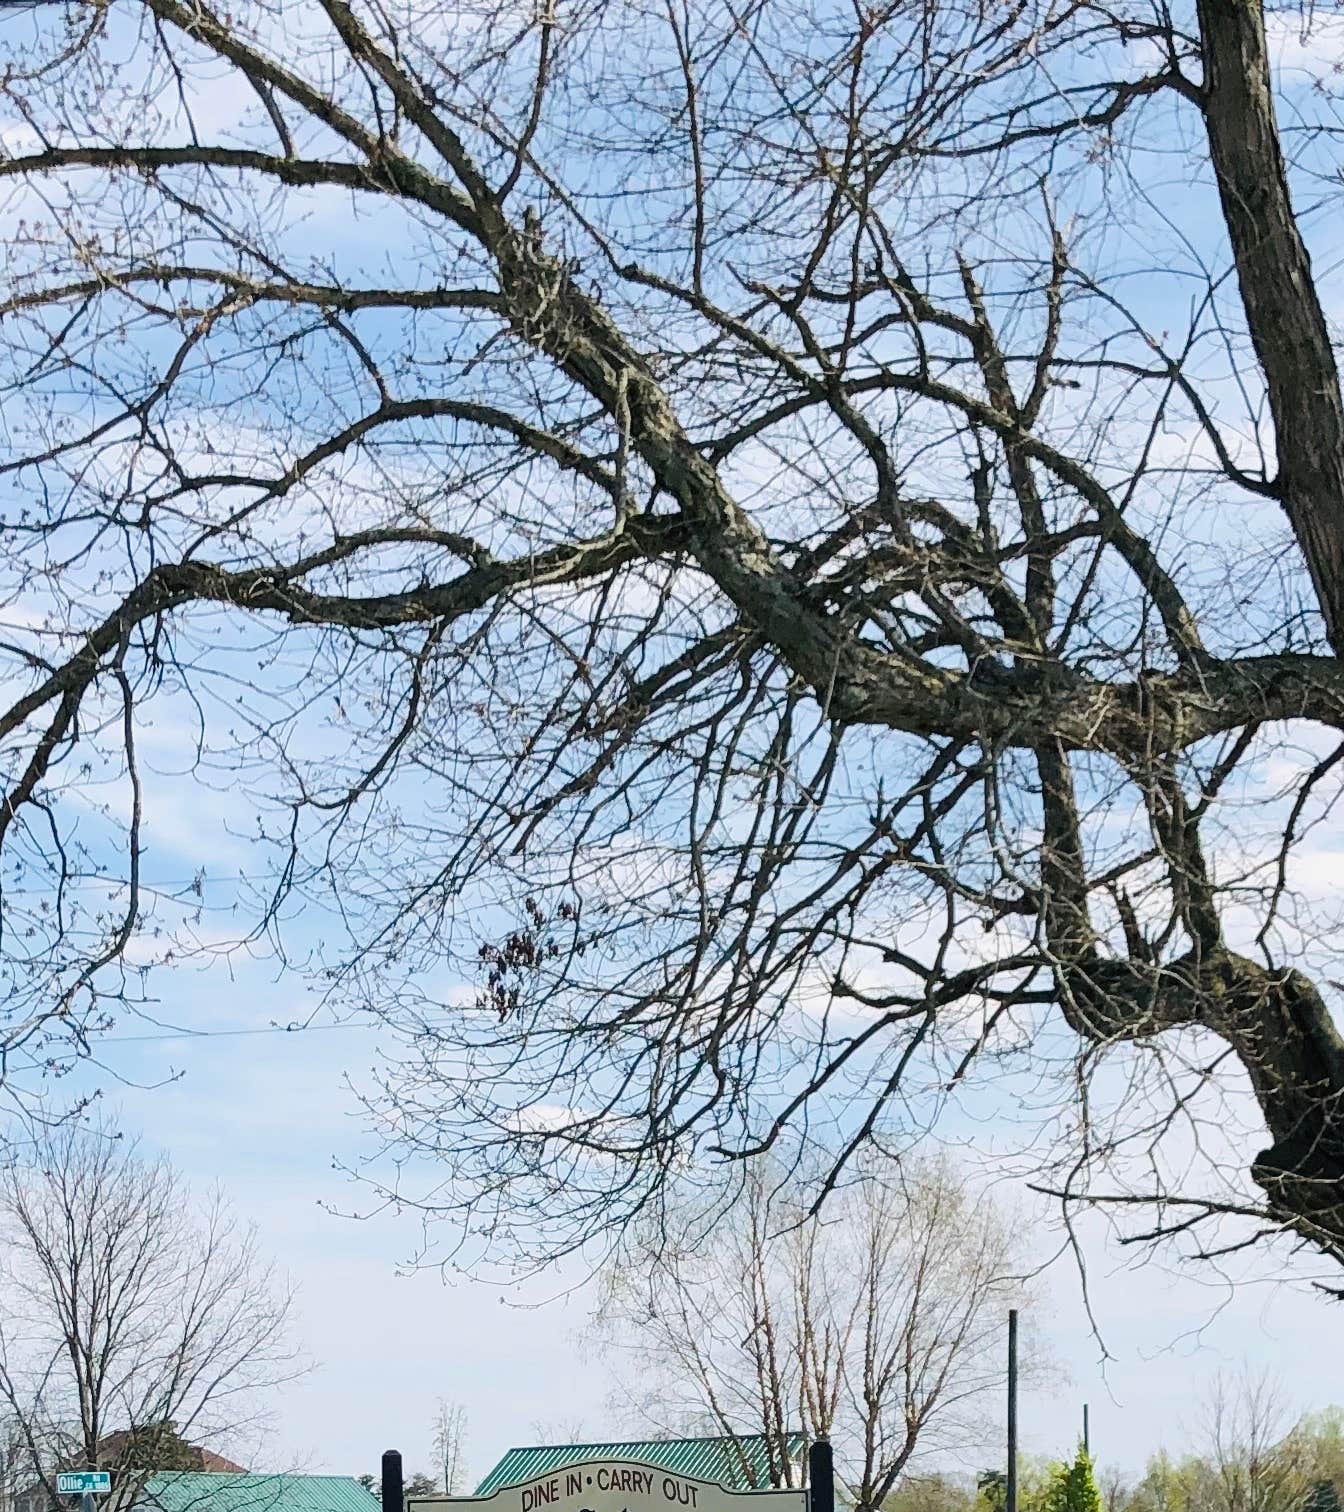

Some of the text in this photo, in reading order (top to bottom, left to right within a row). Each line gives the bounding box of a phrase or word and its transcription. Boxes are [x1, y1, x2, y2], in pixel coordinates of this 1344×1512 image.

[59, 1476, 83, 1490] Ollie
[521, 1468, 699, 1512] DINE IN CARRY OUT
